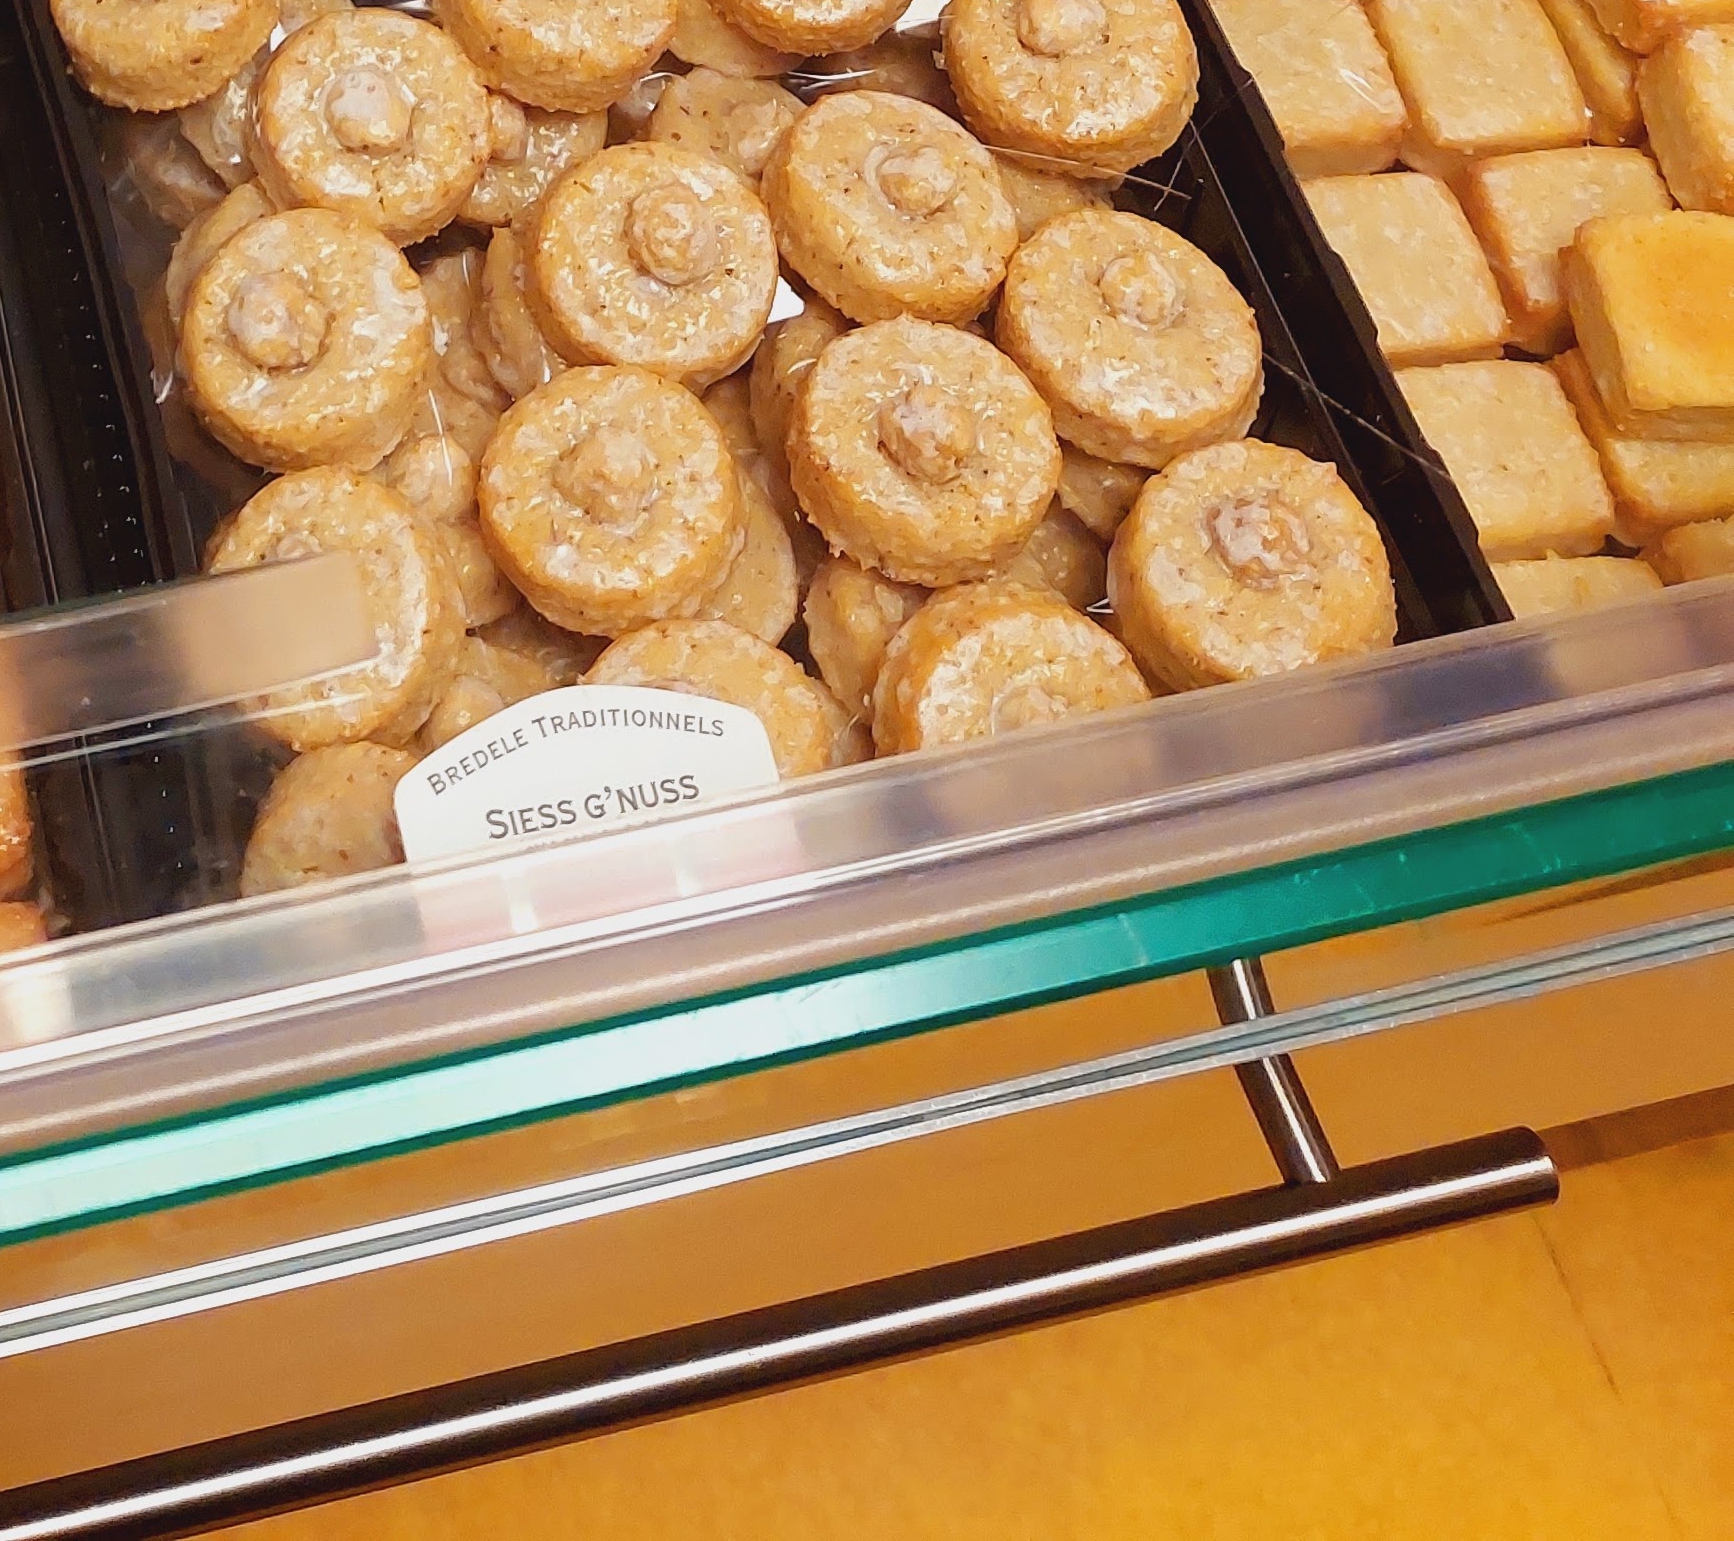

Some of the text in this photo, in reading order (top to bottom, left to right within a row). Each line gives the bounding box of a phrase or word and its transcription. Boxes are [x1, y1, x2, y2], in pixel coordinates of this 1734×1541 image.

[427, 708, 725, 796] BREDELE TRADITIONNELS
[485, 775, 700, 840] SIESS G'NUSS
